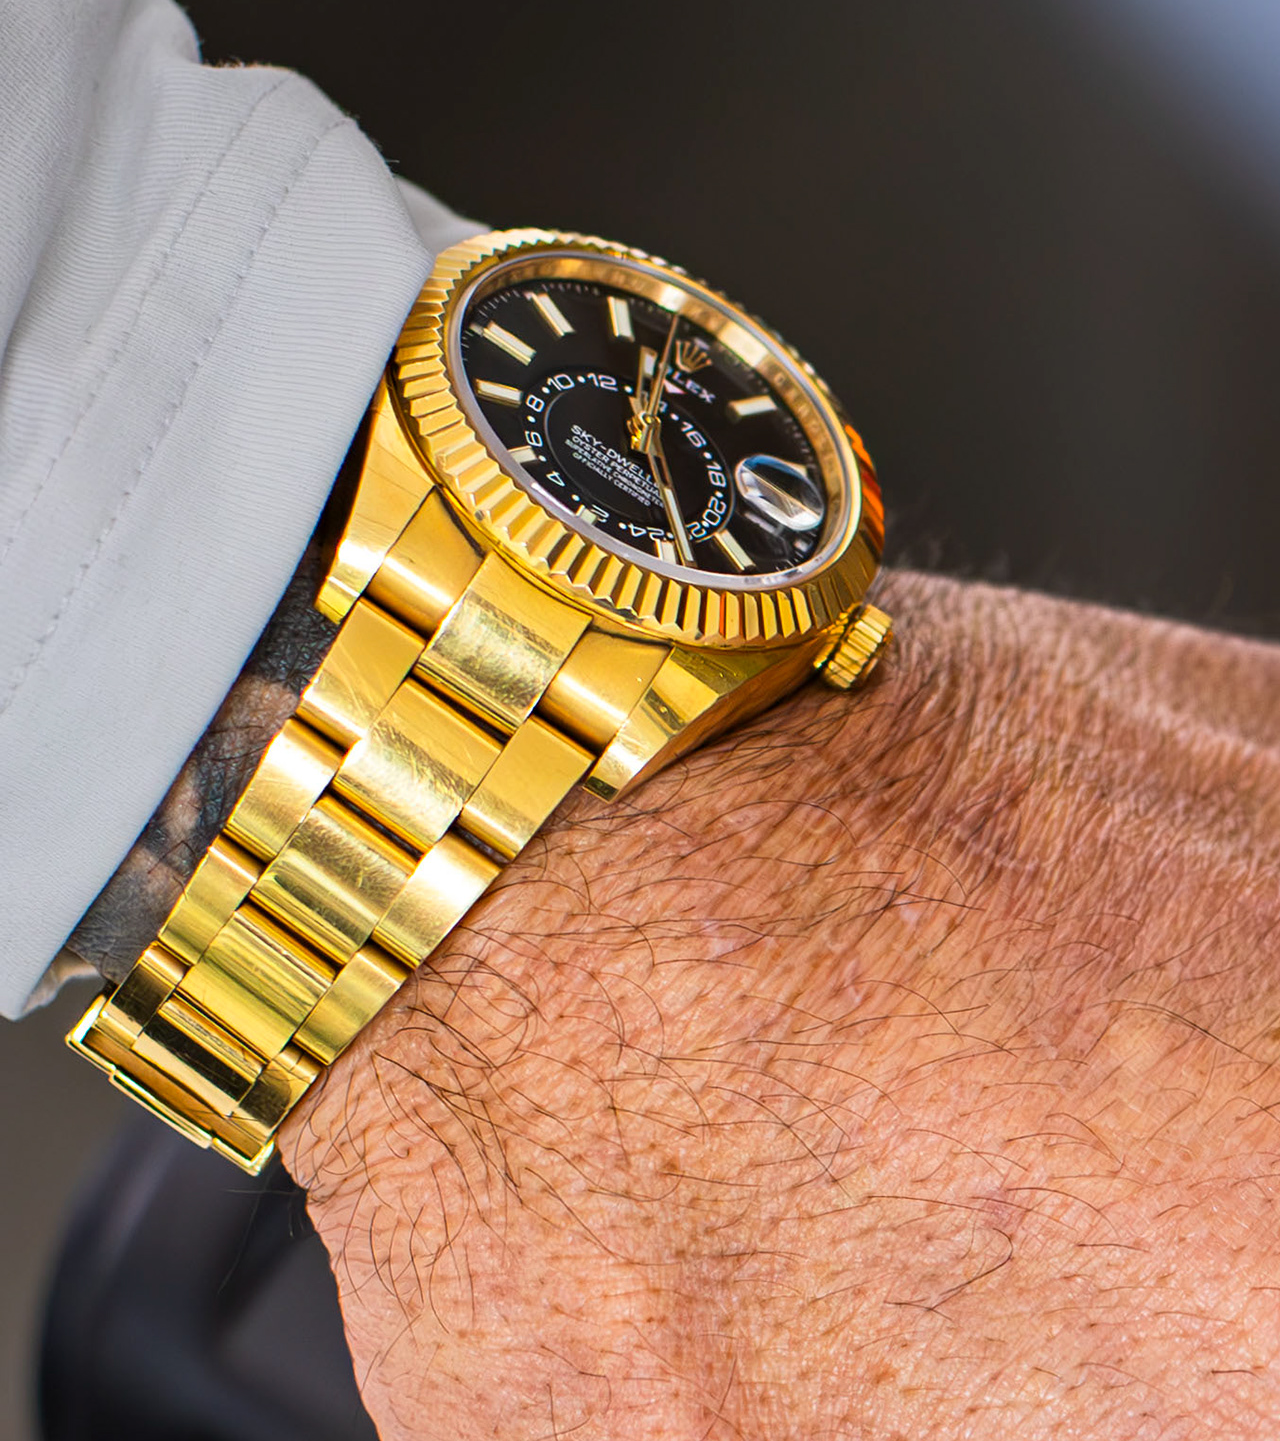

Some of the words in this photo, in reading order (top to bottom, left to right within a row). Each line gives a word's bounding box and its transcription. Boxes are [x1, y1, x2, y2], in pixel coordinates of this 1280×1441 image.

[547, 374, 575, 391] 10
[588, 372, 618, 392] 12
[666, 365, 716, 403] LEX
[526, 394, 545, 413] 8
[524, 430, 543, 447] 6
[681, 421, 707, 448] 16
[571, 424, 659, 488] SKY-DWELL
[572, 435, 609, 463] OYSTER
[546, 470, 566, 487] 4
[572, 452, 613, 481] OFFICIALLY
[613, 479, 651, 507] CERTIFIED
[706, 461, 727, 488] 18
[702, 496, 727, 526] 20
[628, 522, 666, 541] 24
[686, 521, 707, 541] 2
